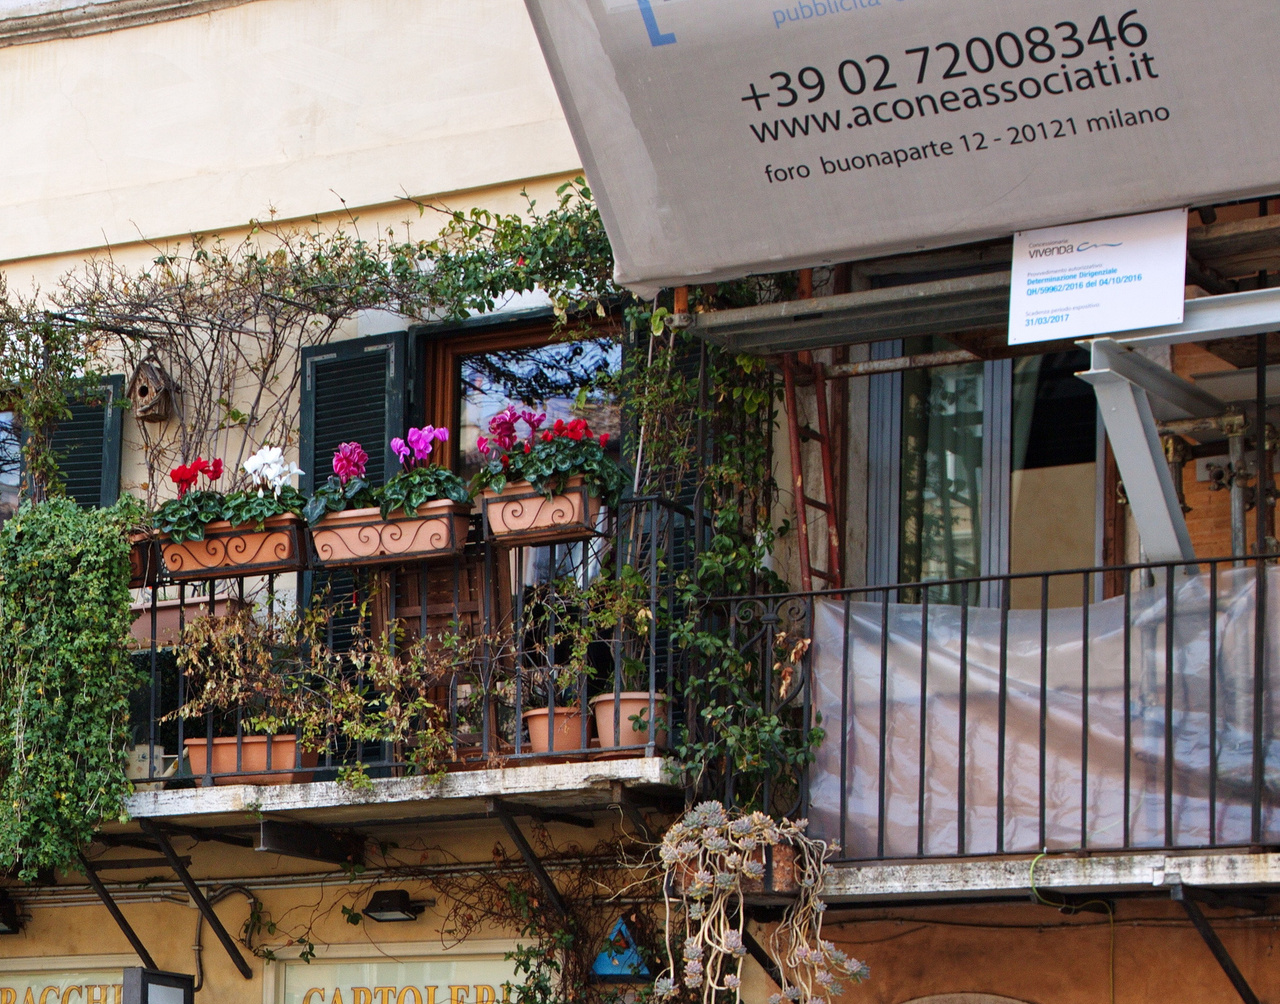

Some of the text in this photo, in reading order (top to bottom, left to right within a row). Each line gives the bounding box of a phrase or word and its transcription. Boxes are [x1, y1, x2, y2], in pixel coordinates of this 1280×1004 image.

[741, 9, 1148, 111] +39 02 72008346
[750, 52, 1159, 143] www.aconeassociati.it
[764, 163, 810, 183] foro
[820, 140, 954, 175] buonaparte
[959, 132, 988, 152] 12
[1007, 117, 1077, 145] 20121
[1086, 106, 1170, 133] milano
[1026, 267, 1118, 286] Determinazione Dirigenziale
[1085, 279, 1097, 288] del
[1099, 273, 1142, 287] 04/10/2016
[1024, 313, 1070, 327] 31/03/2017
